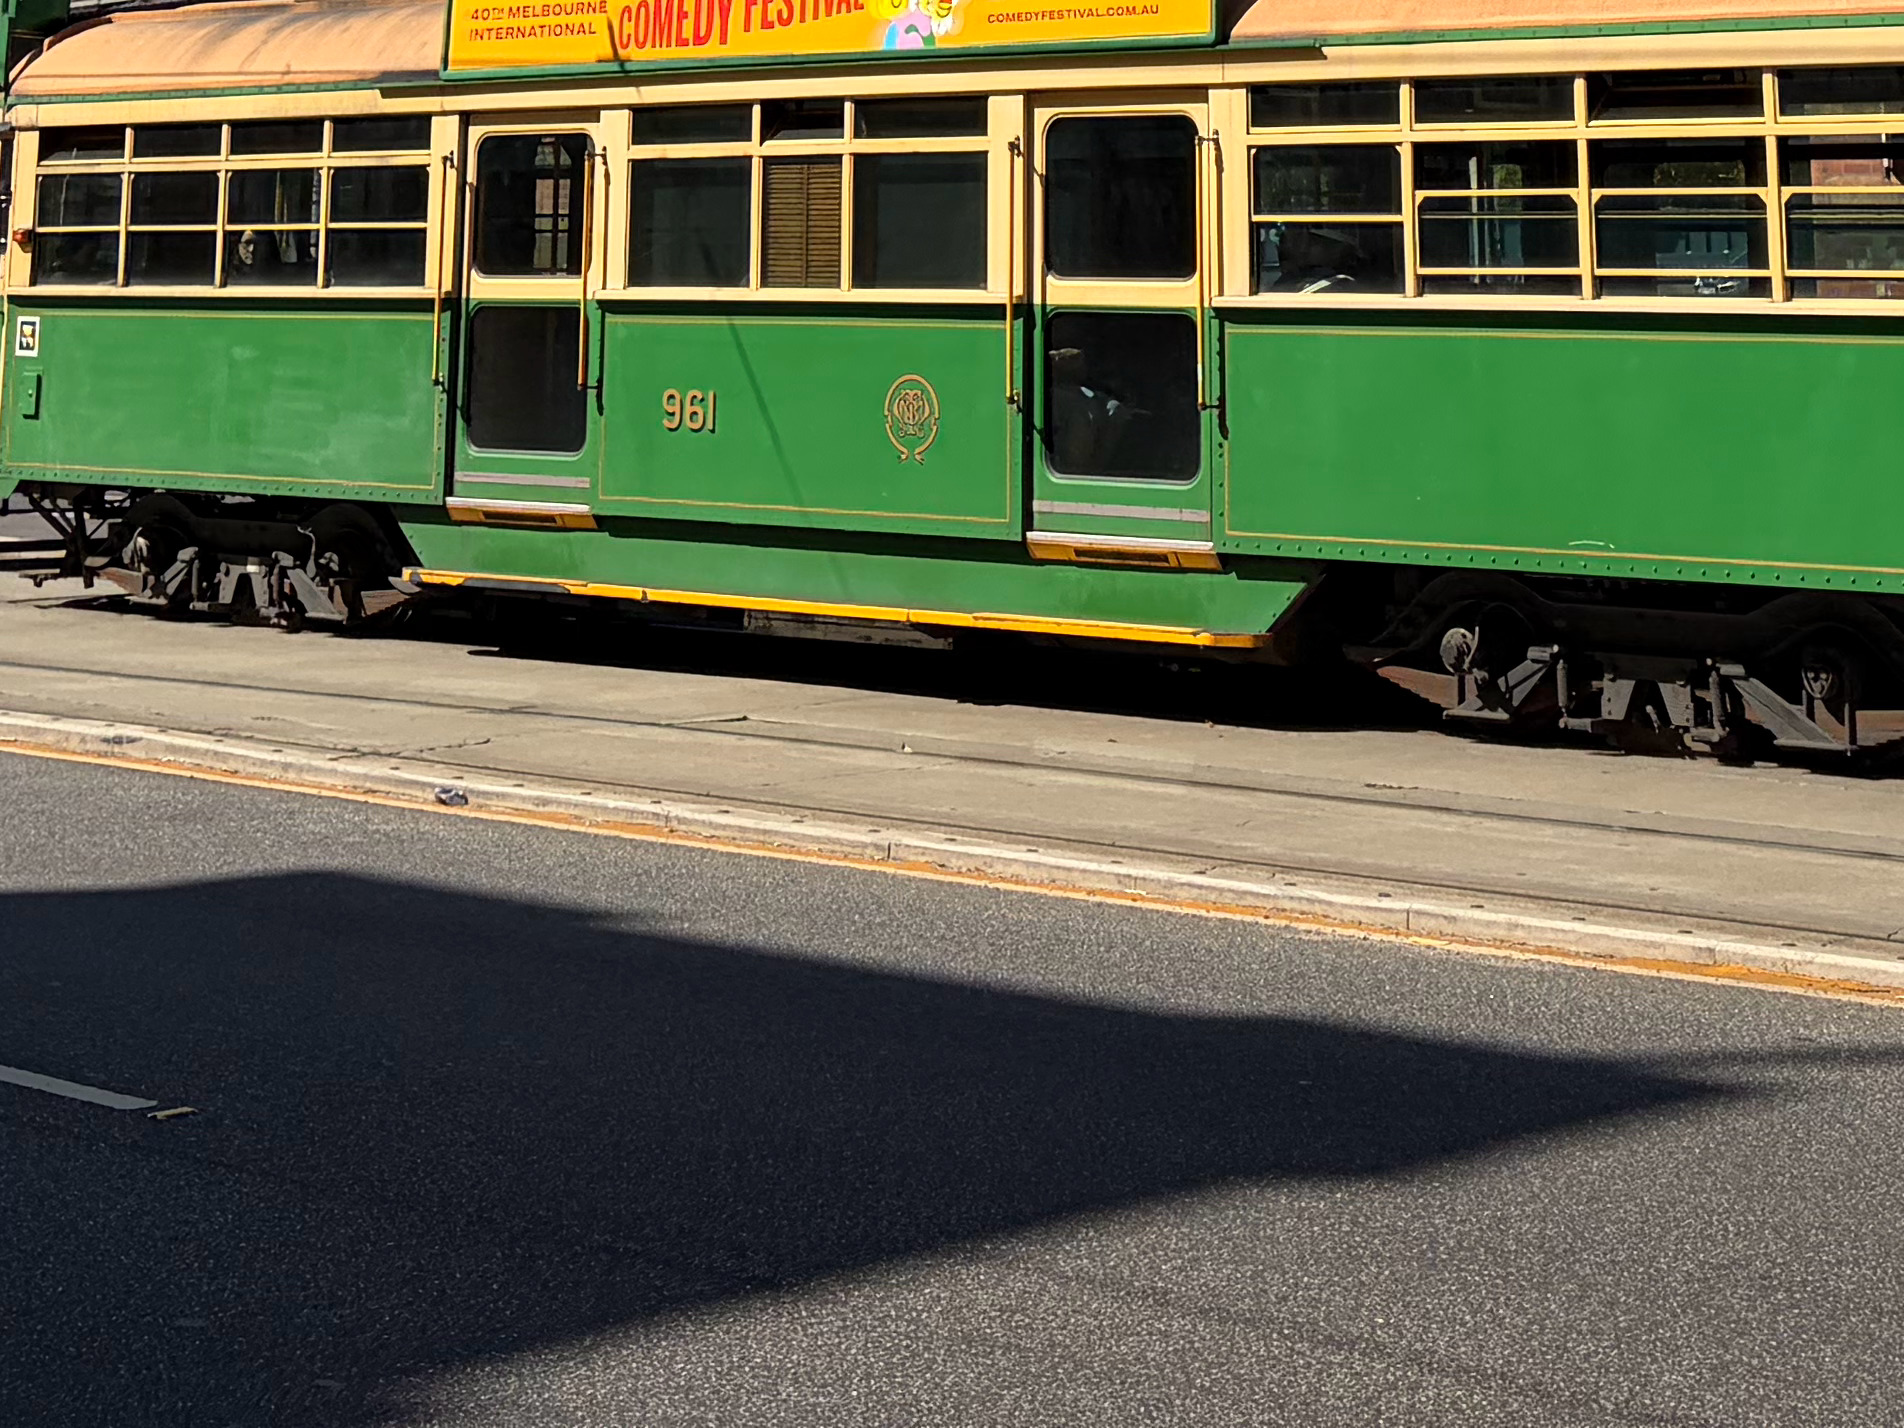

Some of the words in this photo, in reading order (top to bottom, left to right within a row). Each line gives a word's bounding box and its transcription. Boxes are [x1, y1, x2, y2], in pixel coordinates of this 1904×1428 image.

[507, 0, 608, 20] MELBOURNE
[987, 4, 1160, 24] COMEDYFESTIVAL.COM.AU
[469, 22, 597, 42] INTERNATIONAL
[662, 388, 716, 434] 961
